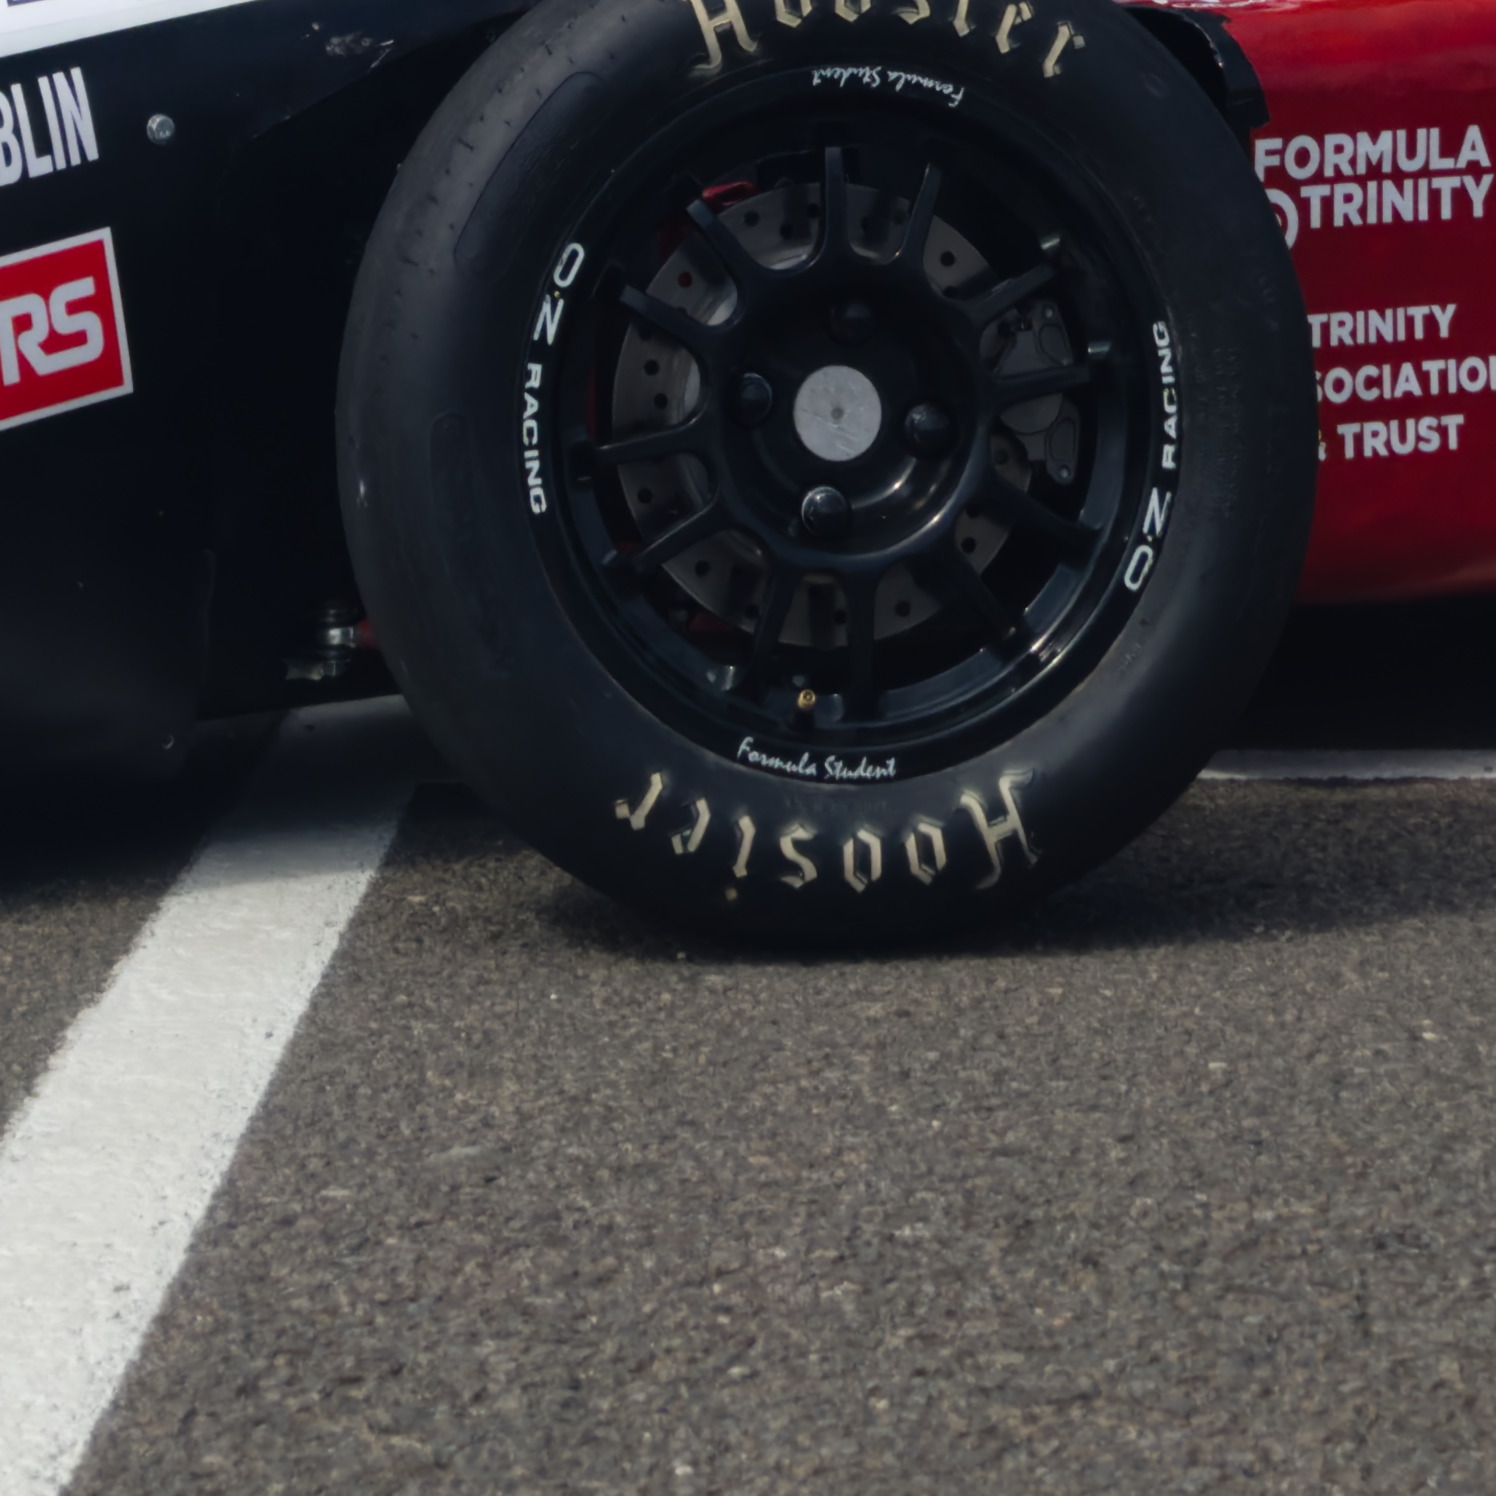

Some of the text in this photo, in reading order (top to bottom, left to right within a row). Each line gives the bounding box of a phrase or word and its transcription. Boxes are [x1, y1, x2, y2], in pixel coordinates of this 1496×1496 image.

[811, 65, 965, 108] Formula Student
[1254, 124, 1493, 182] FORMULA
[1300, 173, 1494, 229] TRINITY
[1306, 303, 1457, 348] TRINITY
[1152, 320, 1178, 470] RACING
[522, 362, 547, 515] RACING
[1337, 414, 1465, 460] TRUST
[736, 736, 897, 780] Formula Student
[615, 768, 1041, 901] Hoosier
